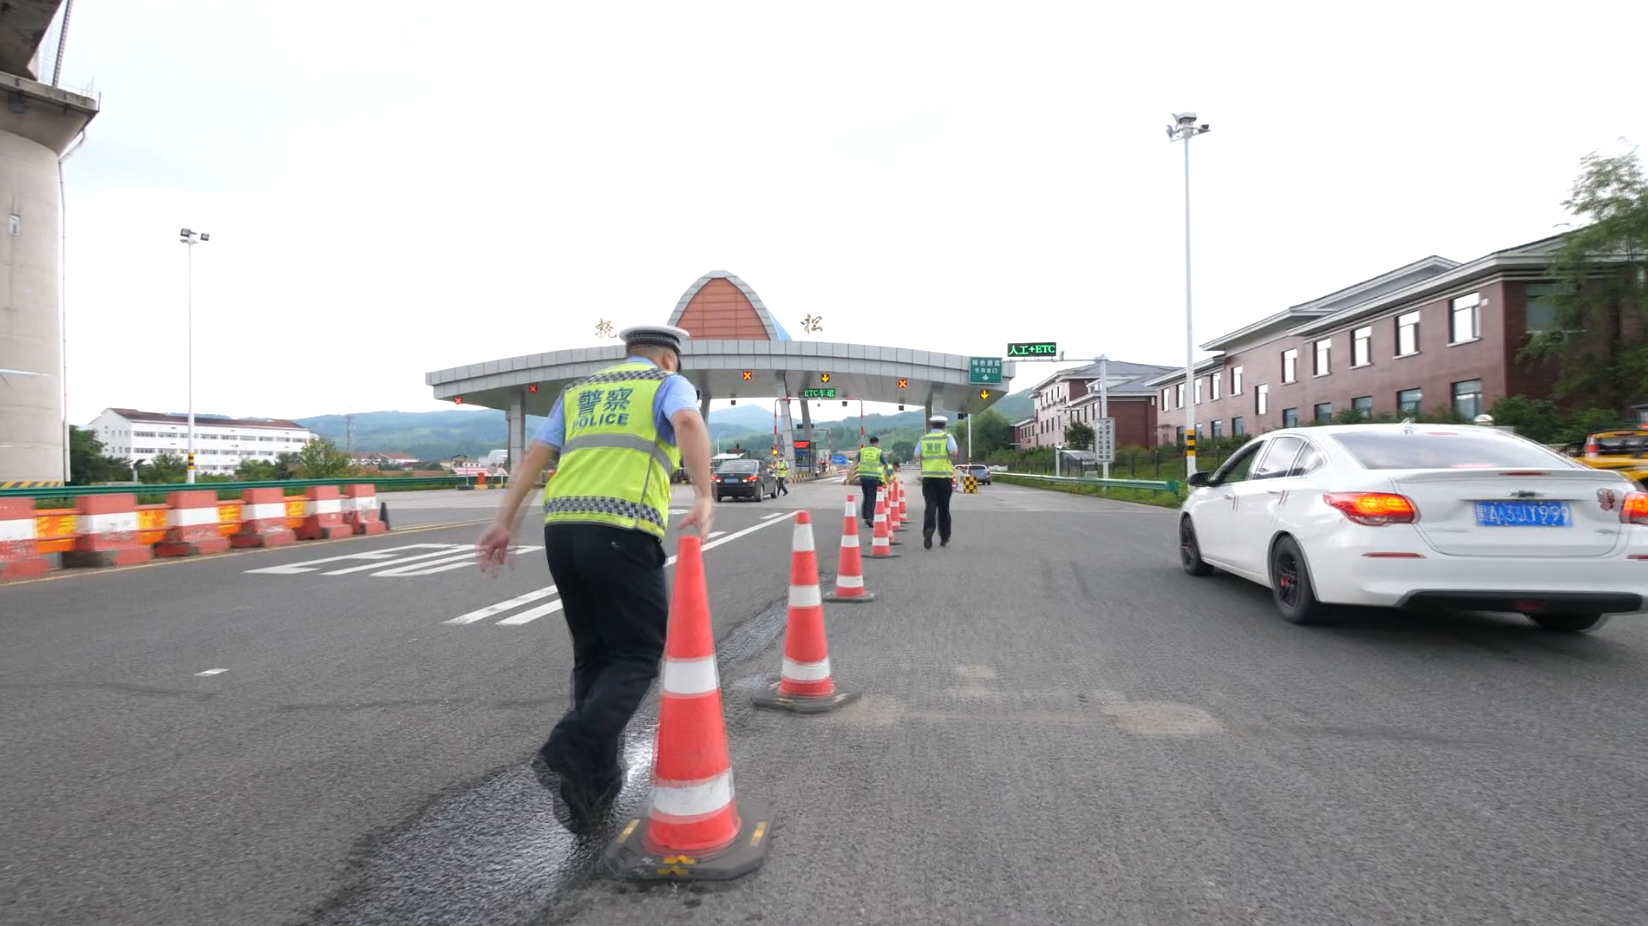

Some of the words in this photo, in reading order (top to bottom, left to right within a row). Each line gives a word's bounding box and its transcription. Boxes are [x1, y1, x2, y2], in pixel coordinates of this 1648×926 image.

[1009, 344, 1055, 356] 人工+ETC
[804, 389, 835, 398] ETC车道
[578, 387, 633, 416] 警察
[572, 413, 629, 431] POLICE
